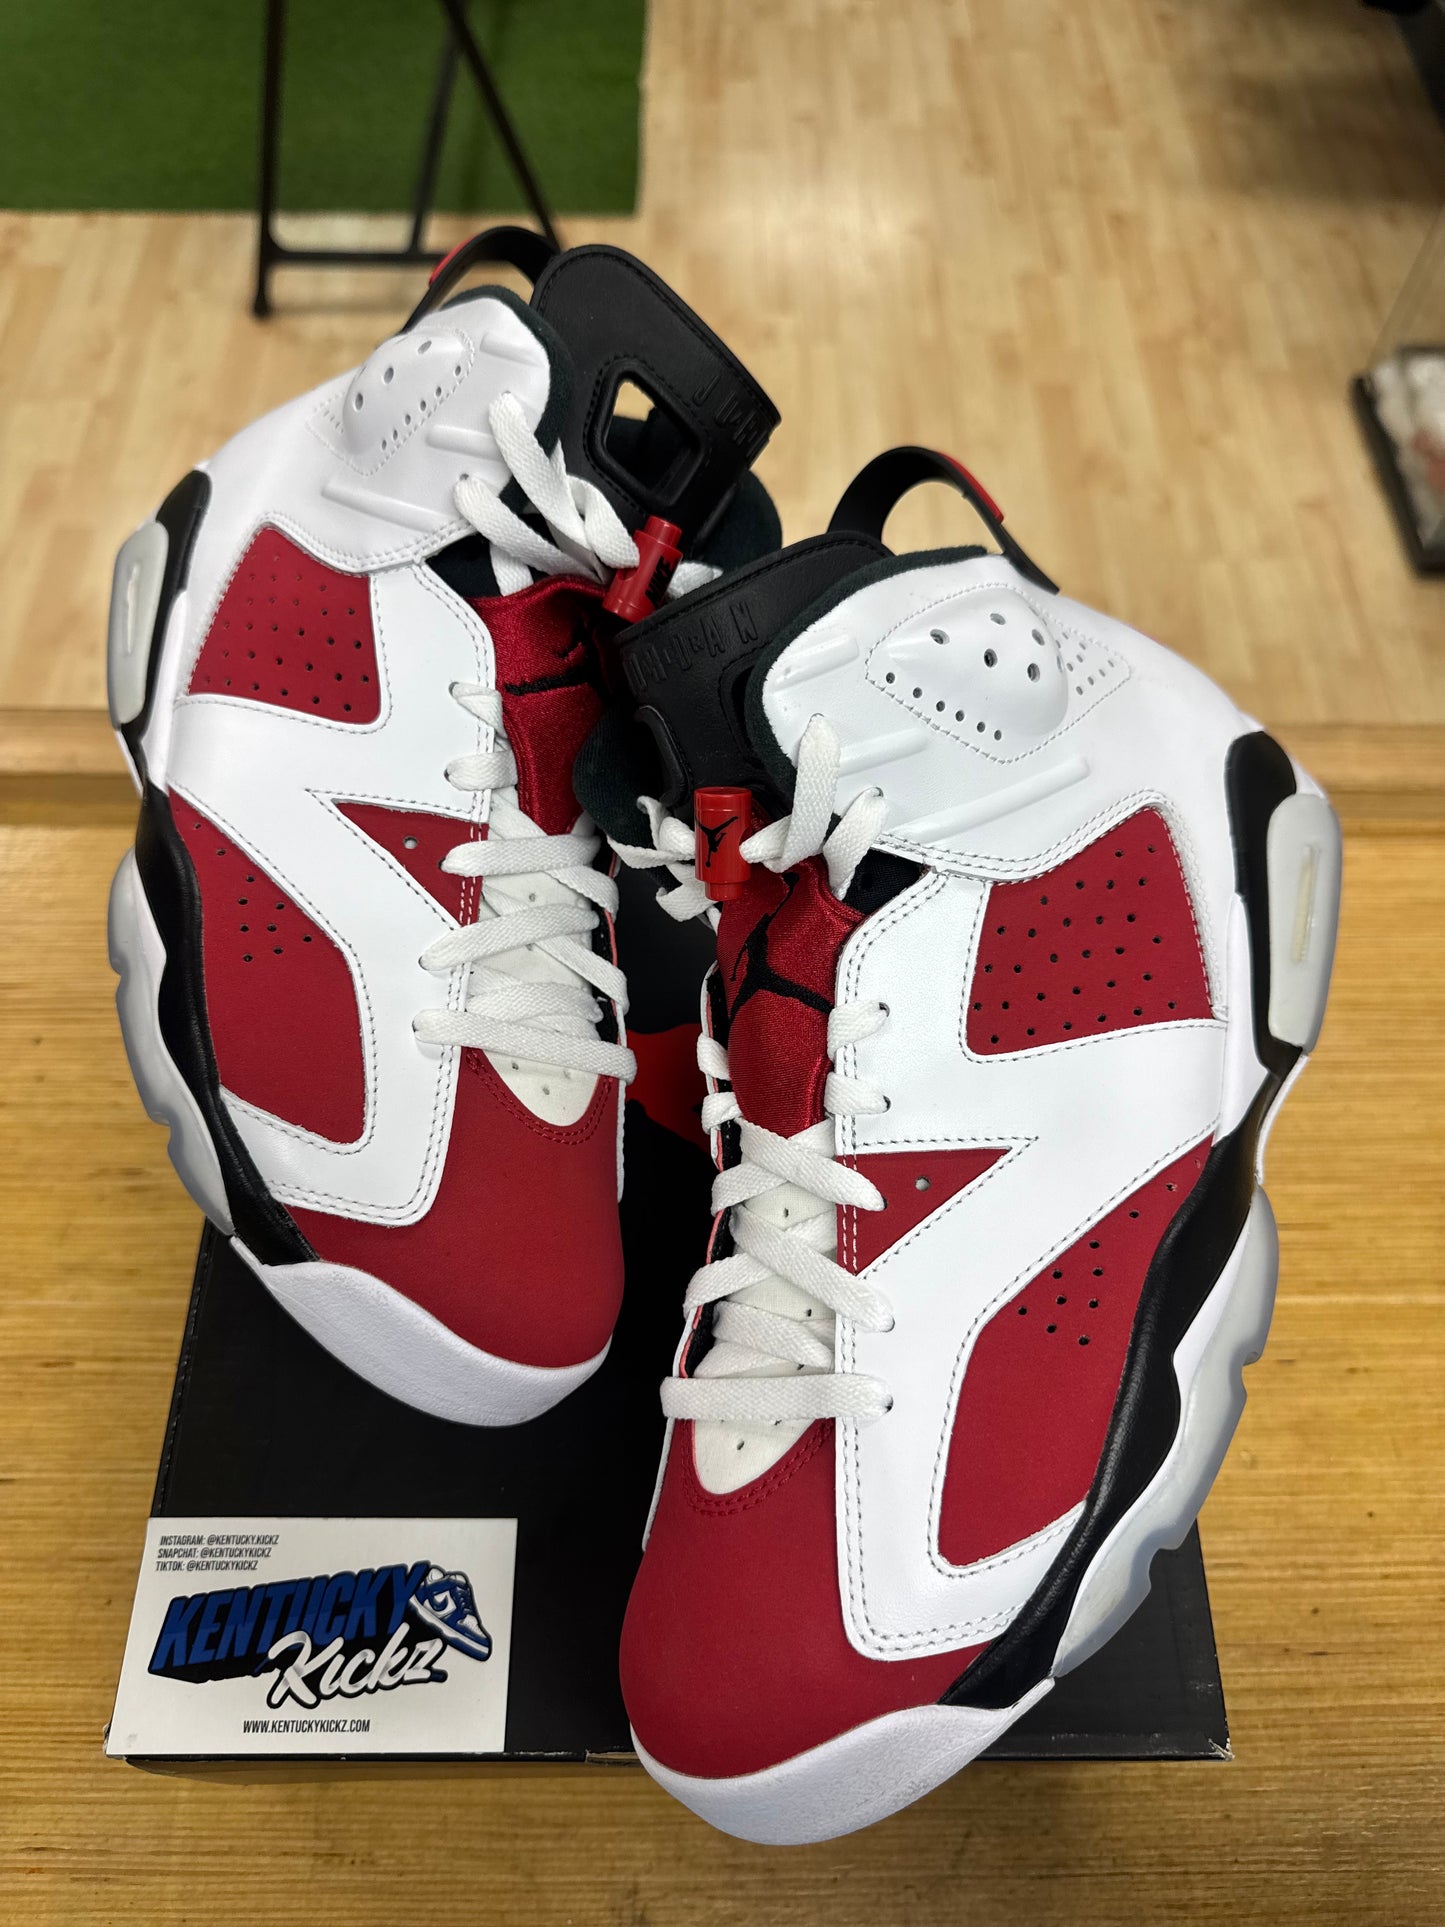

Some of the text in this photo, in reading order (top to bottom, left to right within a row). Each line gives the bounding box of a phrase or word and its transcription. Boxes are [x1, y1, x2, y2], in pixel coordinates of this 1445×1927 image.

[160, 1534, 280, 1546] INSTAGRAM: @KENTUCKY.KICKZ
[158, 1547, 272, 1559] SNAPCHAT: @KENTUCKYKICKZ
[156, 1559, 259, 1572] TIKTOK: @KENTUCKYKICKZ
[149, 1560, 431, 1675] KENTUCKY
[267, 1621, 443, 1708] Kickz
[243, 1719, 371, 1733] WWW.KENTUCKYKICKZ.COM
